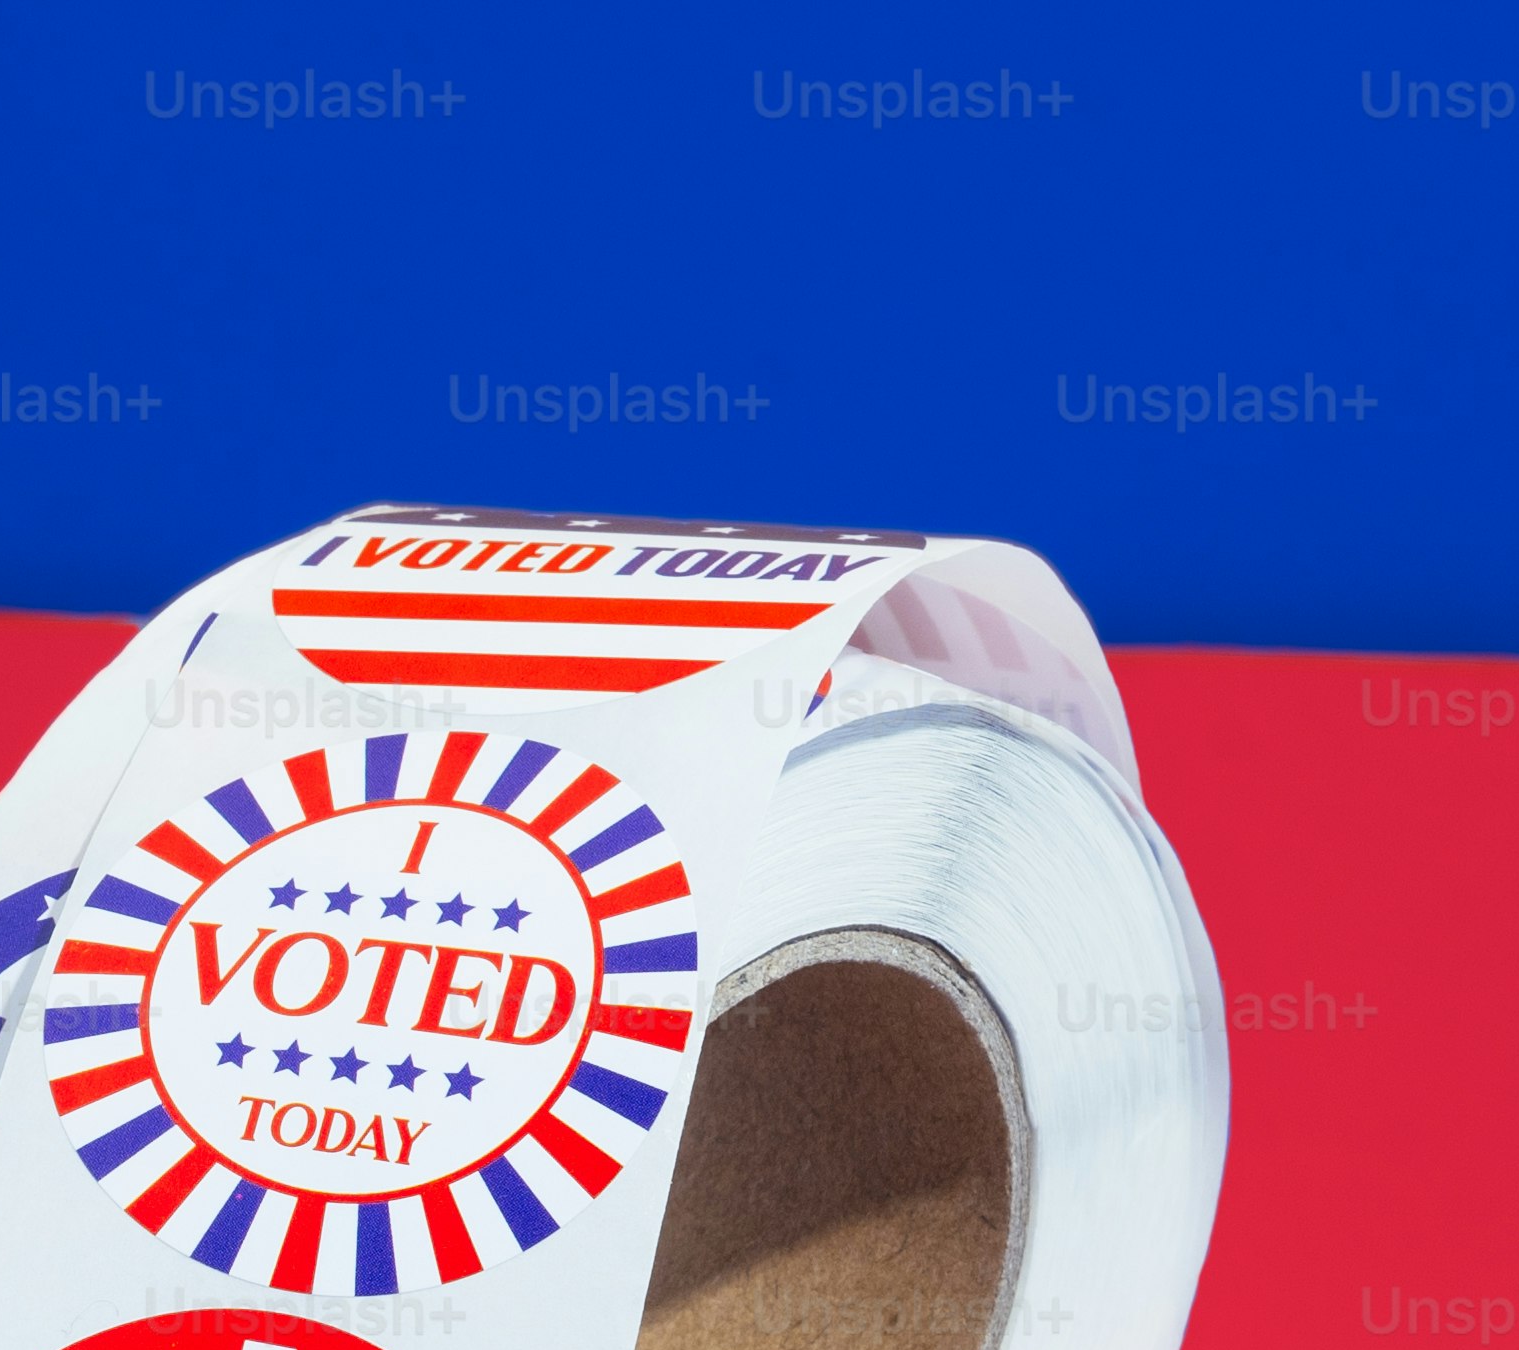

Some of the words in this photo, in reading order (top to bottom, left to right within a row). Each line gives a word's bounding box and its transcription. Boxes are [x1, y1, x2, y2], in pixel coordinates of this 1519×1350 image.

[301, 537, 348, 565] I
[354, 539, 614, 572] VOTED
[615, 547, 890, 581] TODAY
[400, 821, 438, 874] I
[189, 922, 579, 1046] VOTED
[237, 1096, 432, 1166] TODAY
